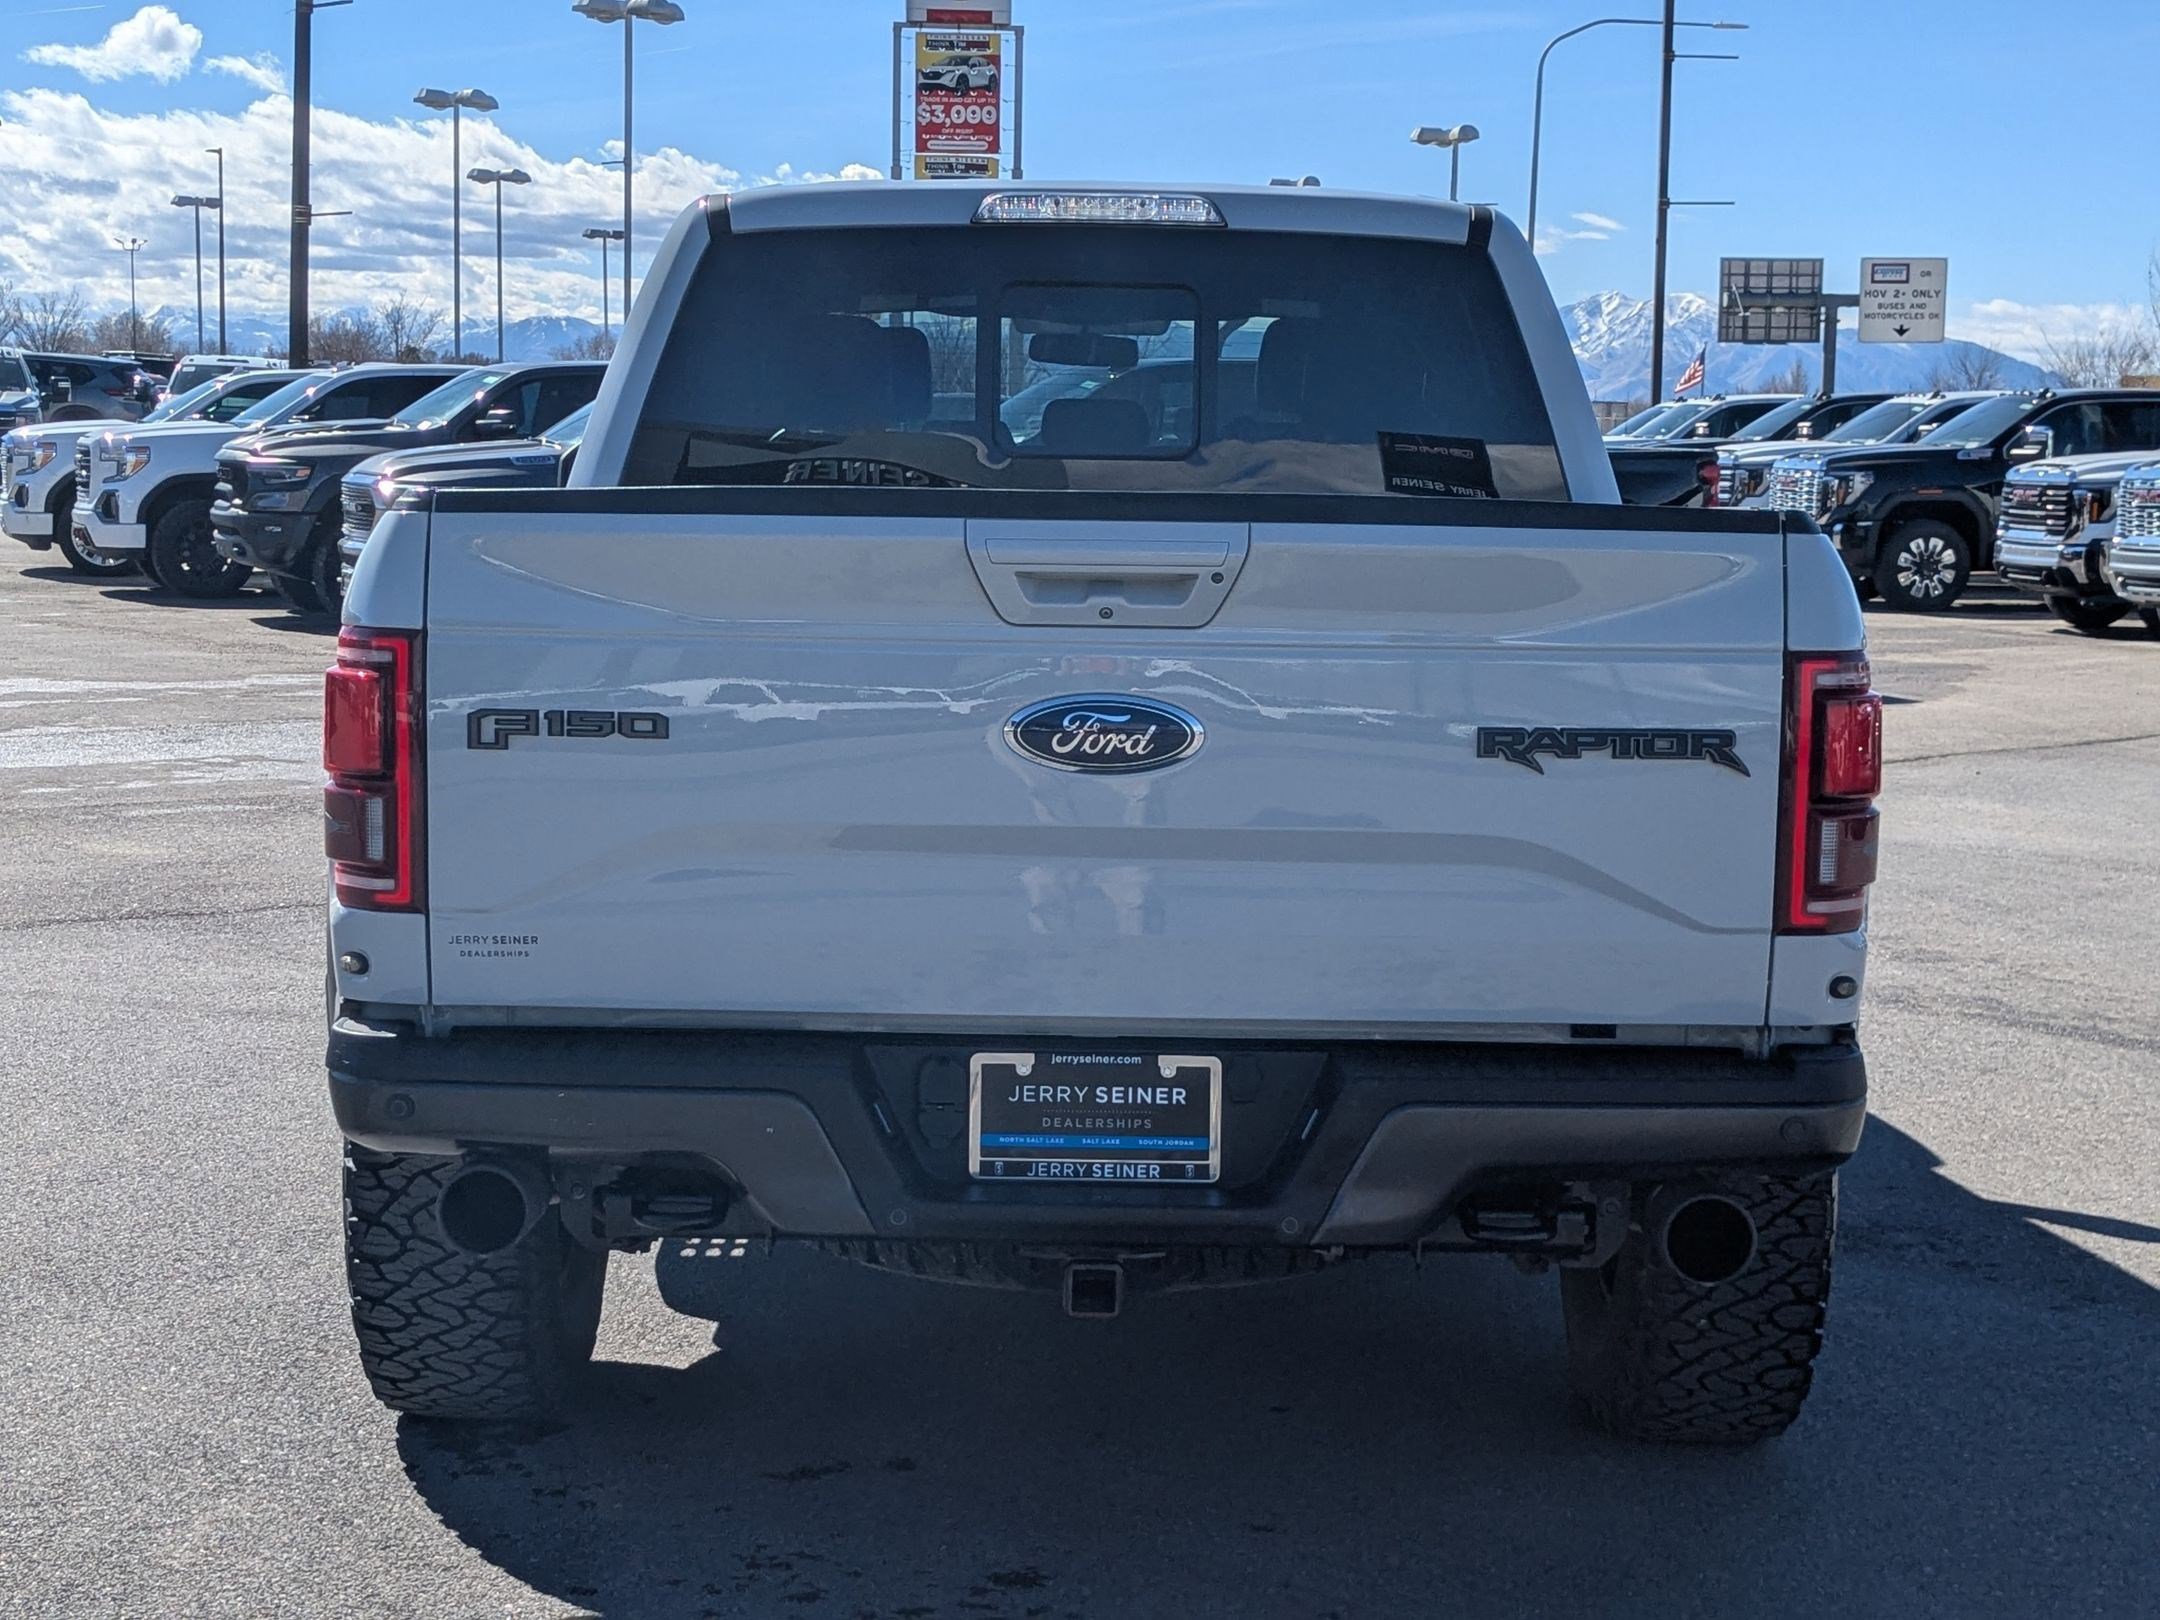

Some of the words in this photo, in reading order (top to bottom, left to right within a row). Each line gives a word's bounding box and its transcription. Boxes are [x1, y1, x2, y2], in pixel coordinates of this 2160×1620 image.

[917, 102, 997, 127] $3,000
[1920, 270, 1932, 278] OR
[1864, 289, 1887, 298] HOV
[1911, 289, 1942, 298] ONLY
[1877, 302, 1905, 310] BUSES
[1909, 302, 1927, 310] AND
[1051, 711, 1157, 755] Ford
[1476, 726, 1751, 777] RAPTOR
[448, 935, 489, 945] JERRY
[492, 935, 539, 945] SEINER
[1050, 1053, 1142, 1065] jerryseiner.com
[1008, 1085, 1089, 1102] JERRY
[1095, 1086, 1187, 1104] SEINER
[1042, 1117, 1152, 1129] DEALERSHIPS
[1027, 1163, 1089, 1177] JERRY
[1092, 1163, 1160, 1178] SEINER
